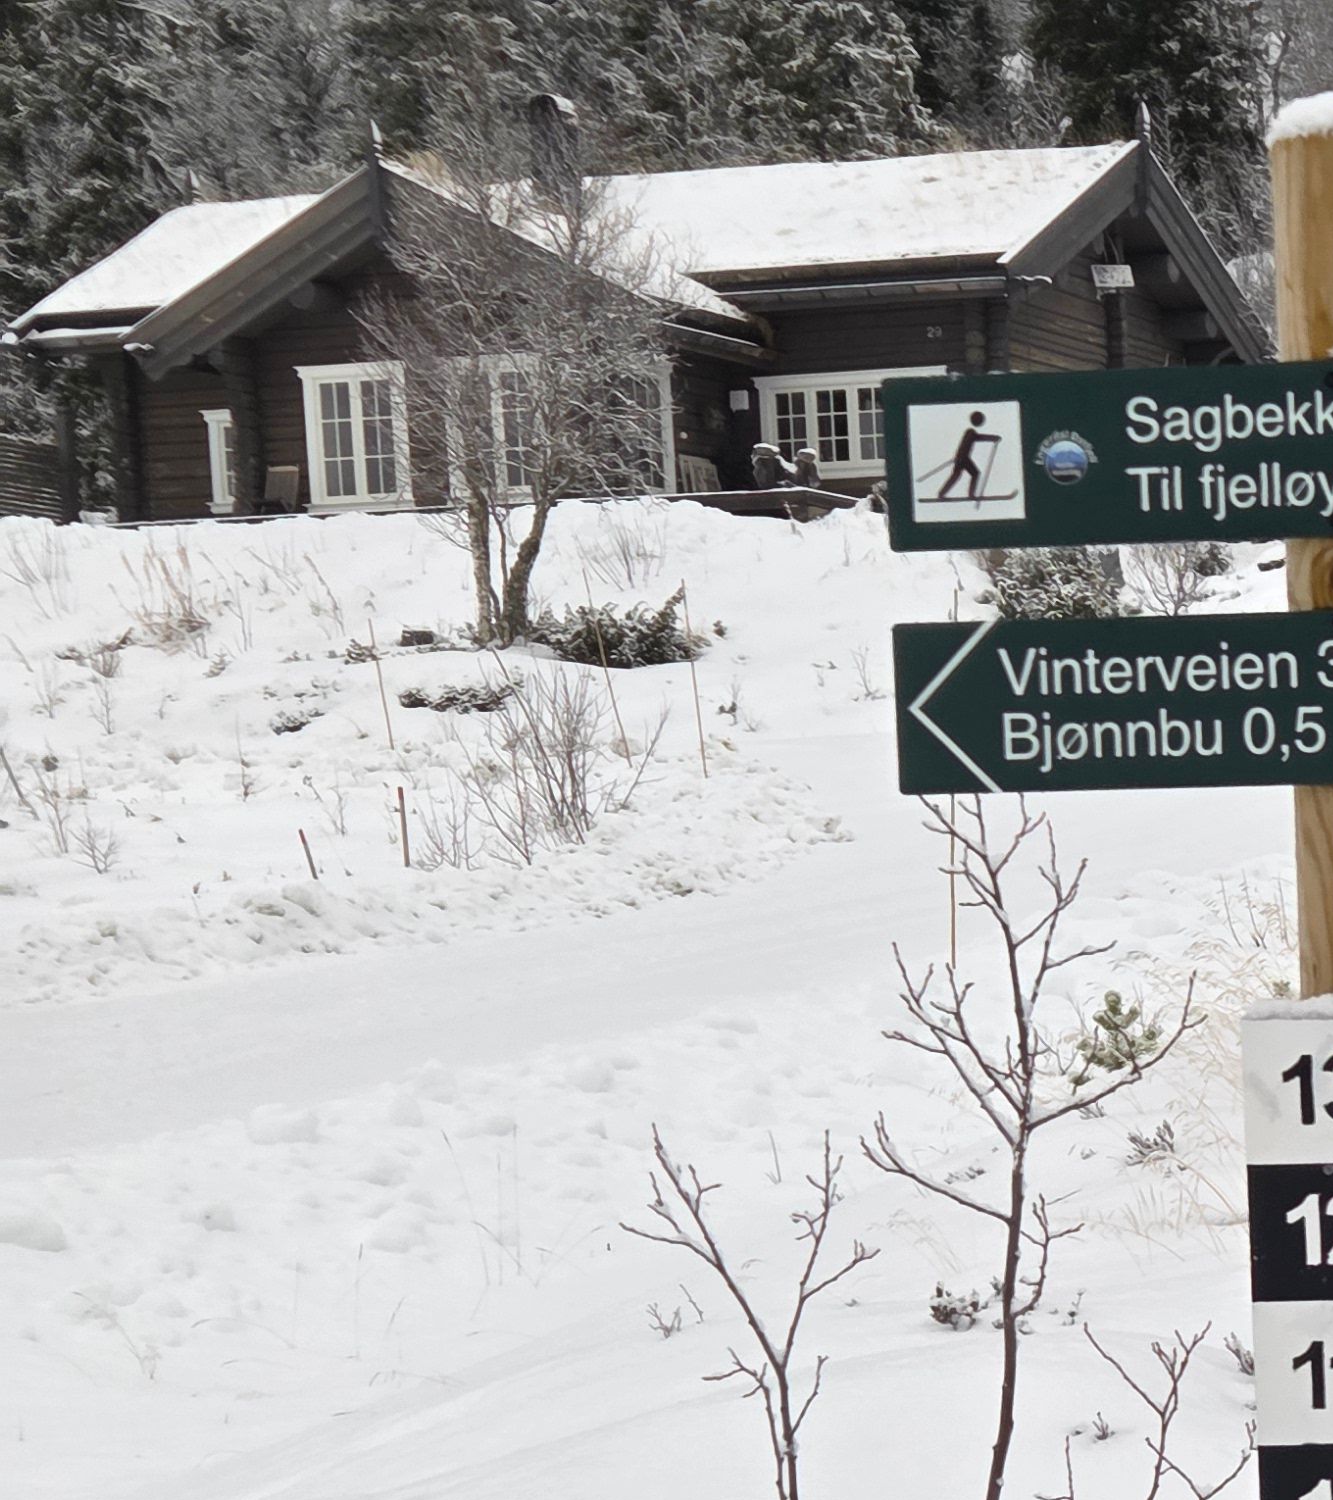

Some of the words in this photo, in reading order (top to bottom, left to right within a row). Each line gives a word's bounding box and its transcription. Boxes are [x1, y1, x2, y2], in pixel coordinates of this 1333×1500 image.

[1125, 464, 1183, 512] Til
[997, 642, 1299, 695] Vinterveien
[1002, 708, 1224, 773] Bjønnbu
[1243, 706, 1327, 762] 0,5
